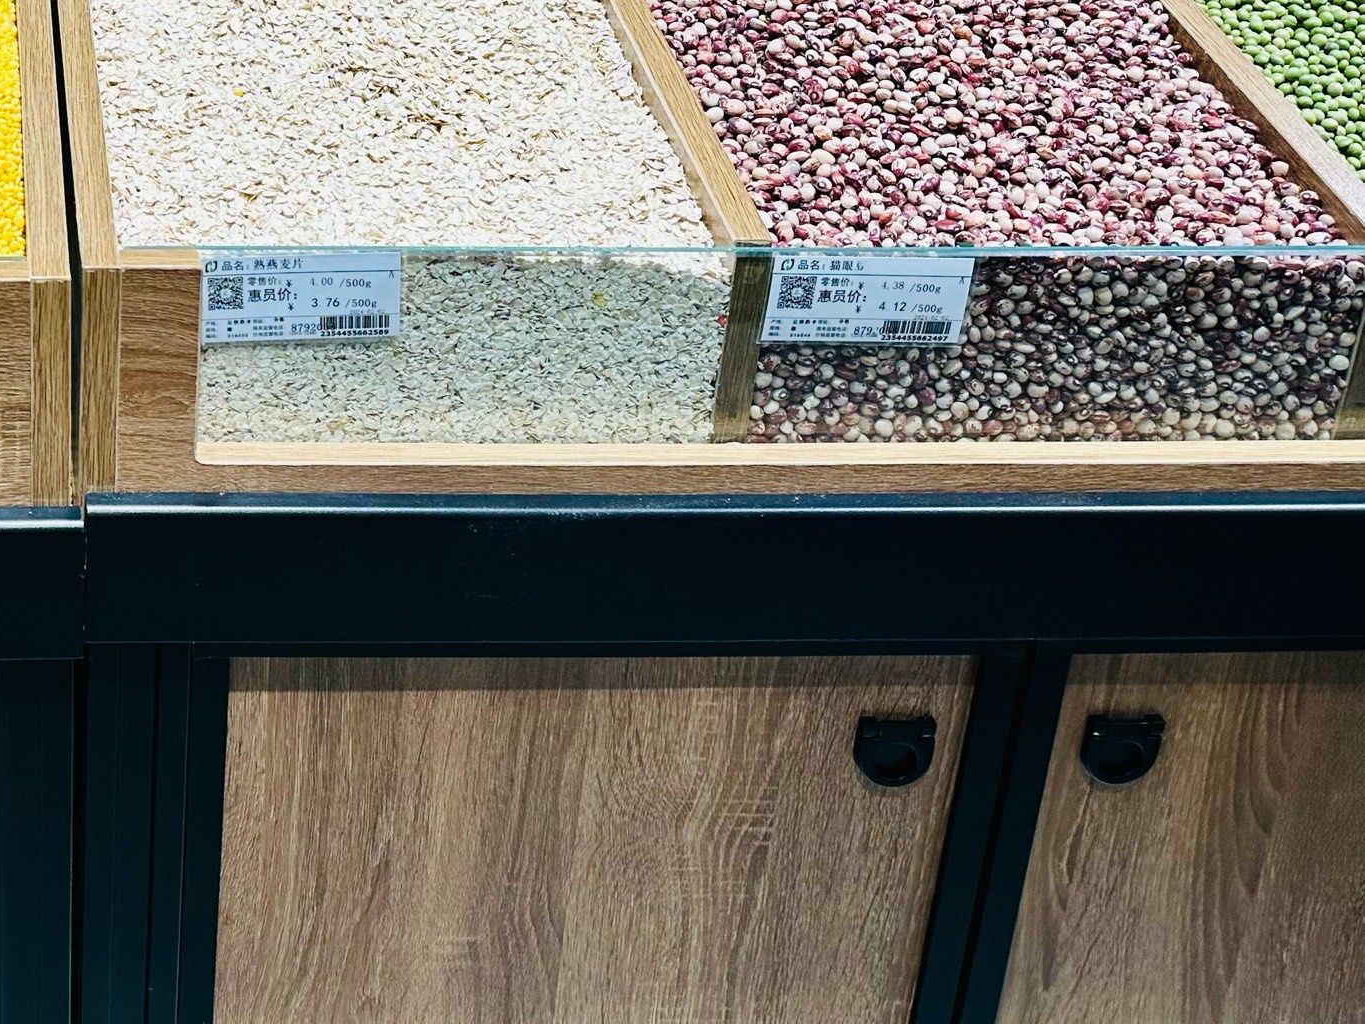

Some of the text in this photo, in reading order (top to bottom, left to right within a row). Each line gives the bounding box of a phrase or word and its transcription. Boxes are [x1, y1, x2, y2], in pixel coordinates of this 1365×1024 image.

[339, 278, 371, 288] /500g
[910, 283, 941, 294] /500g
[346, 298, 377, 308] /500g
[911, 304, 943, 314] /500g
